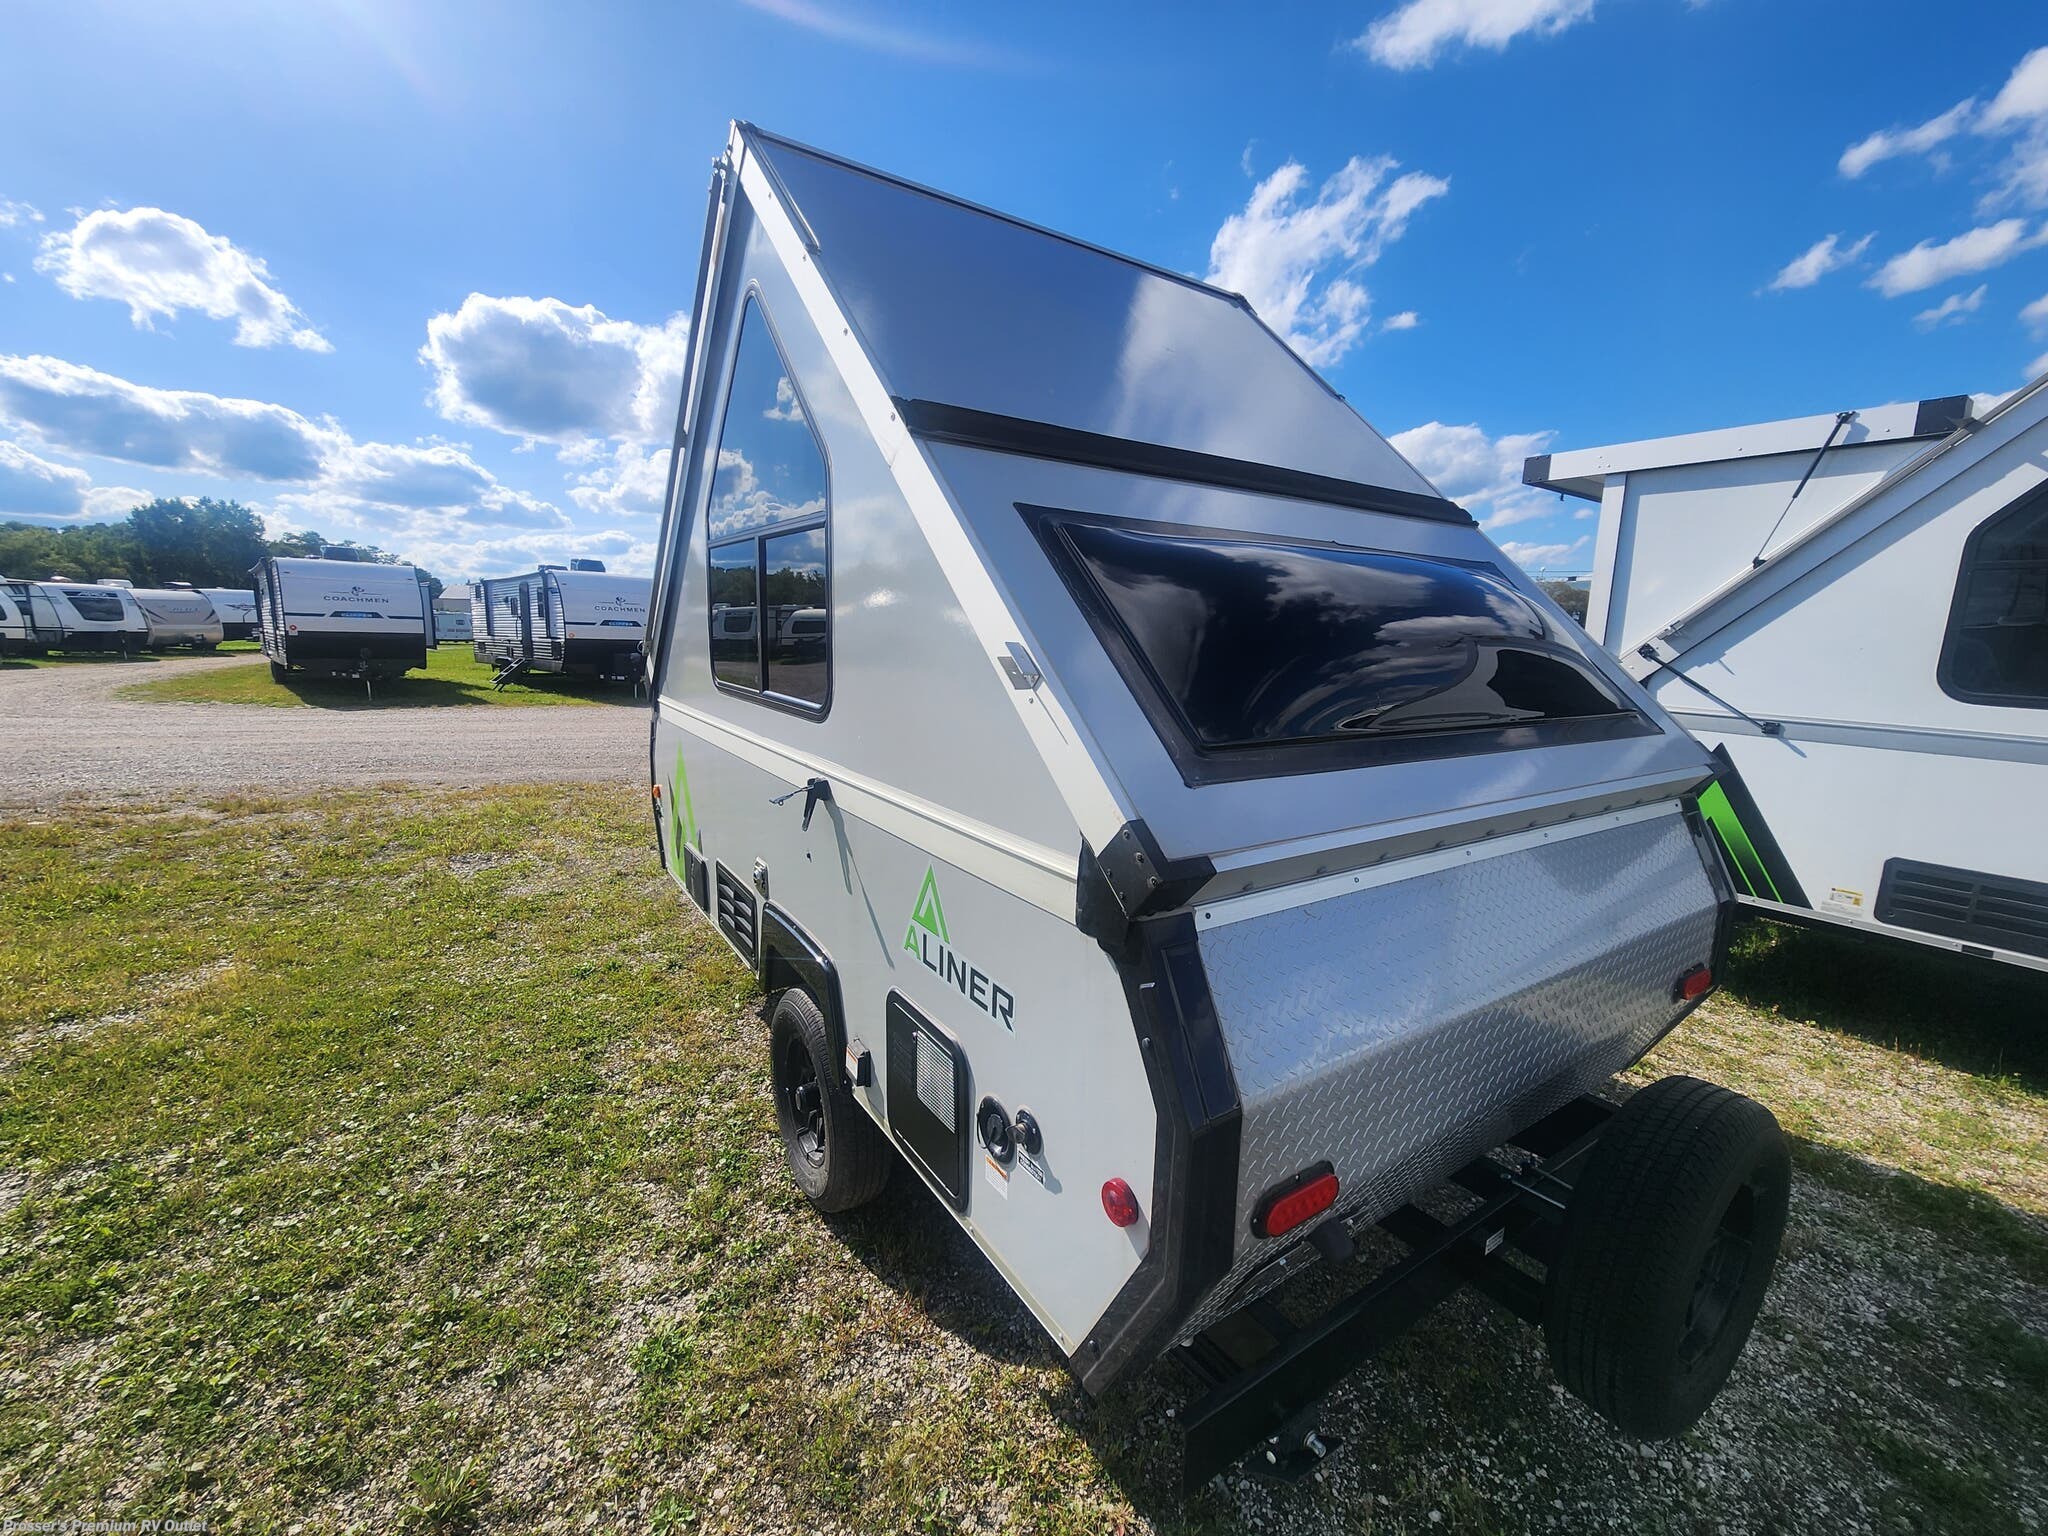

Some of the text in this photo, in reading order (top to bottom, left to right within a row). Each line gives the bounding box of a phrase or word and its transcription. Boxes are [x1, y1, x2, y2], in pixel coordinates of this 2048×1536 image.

[323, 595, 389, 603] COACHMEN
[594, 605, 646, 613] COACHMEN
[903, 924, 1014, 1033] ALINER
